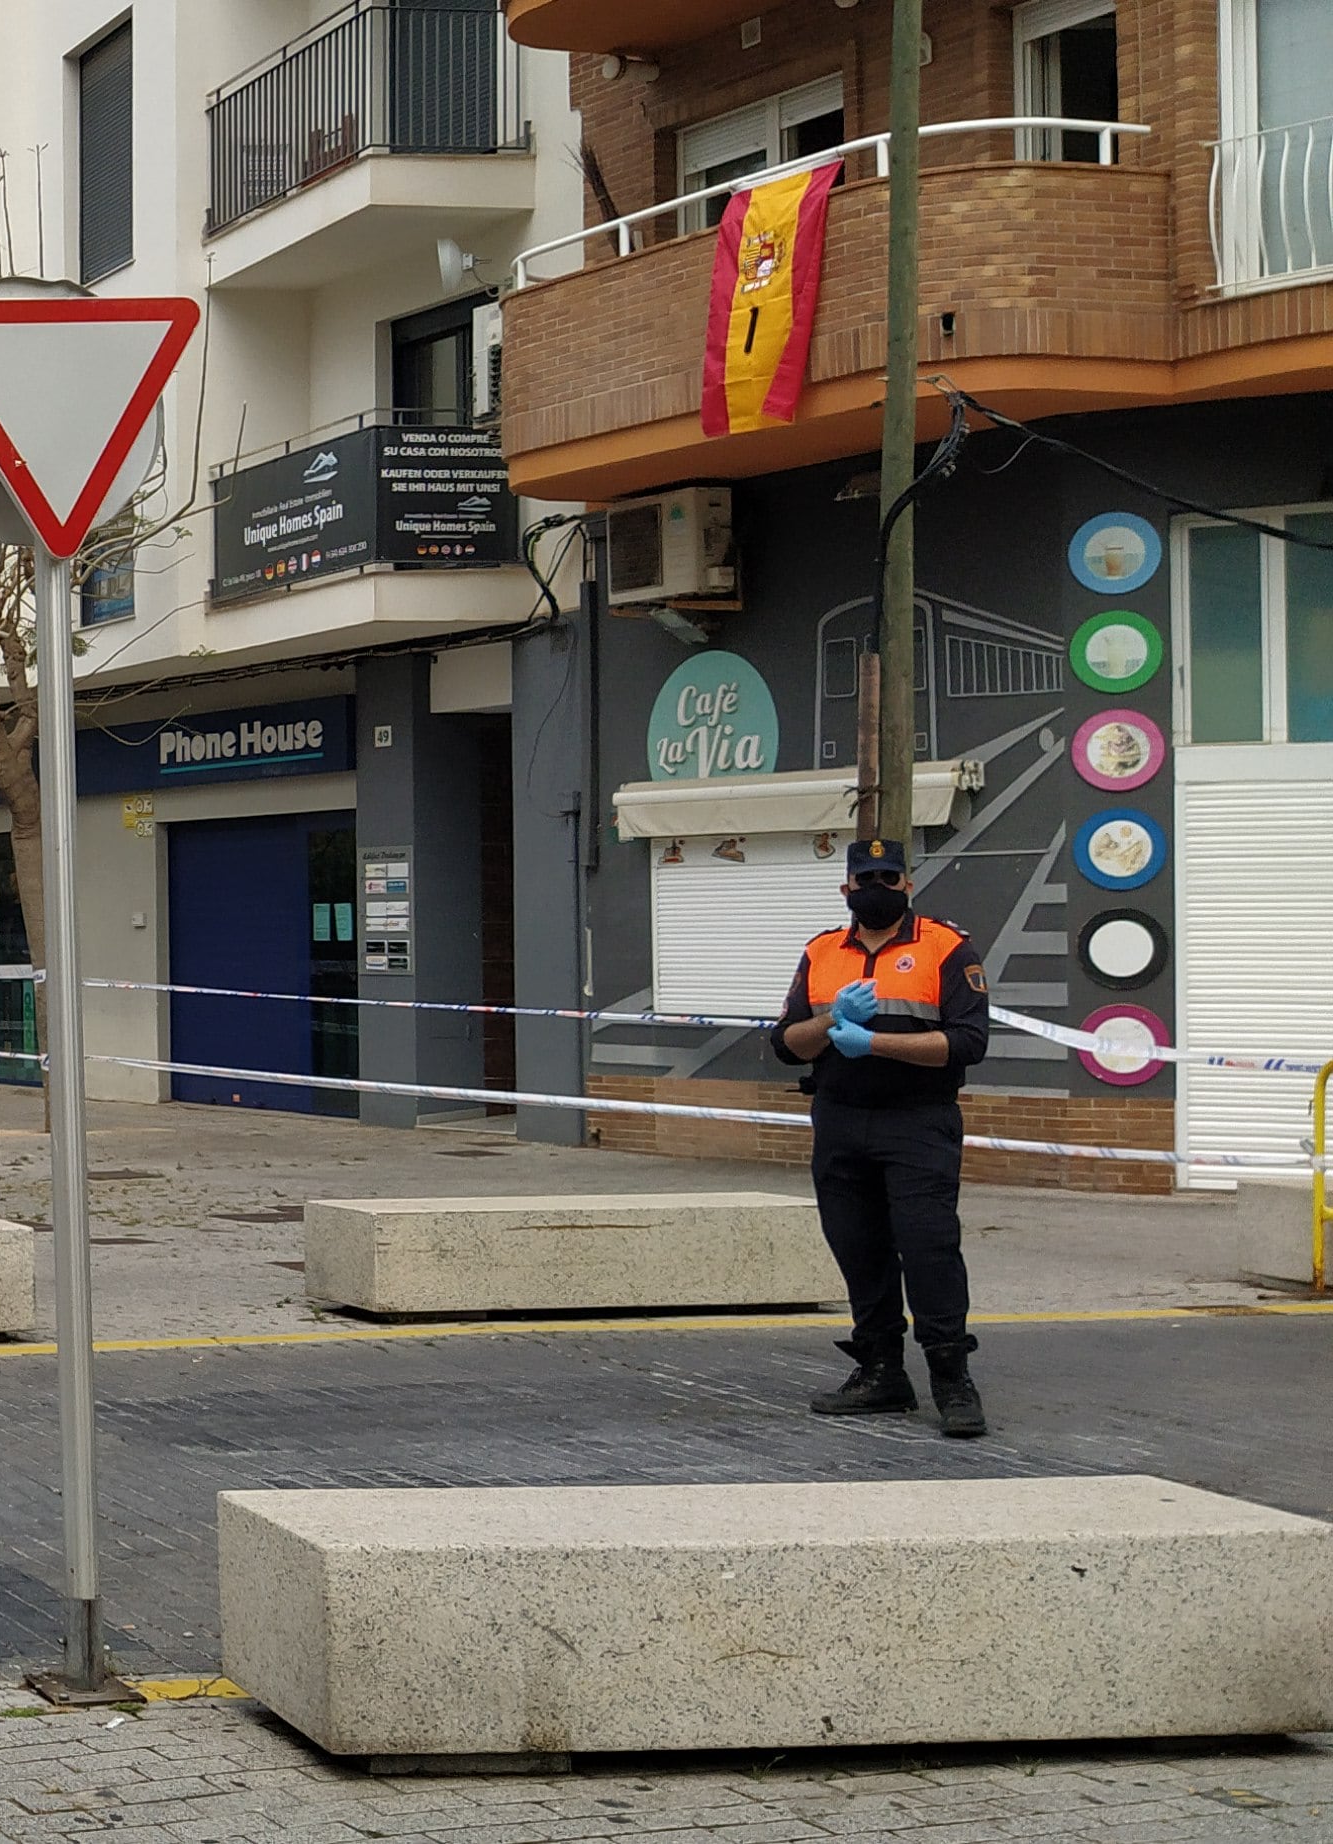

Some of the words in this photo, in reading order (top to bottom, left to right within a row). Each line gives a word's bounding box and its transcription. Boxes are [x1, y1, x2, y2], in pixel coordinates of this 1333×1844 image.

[401, 433, 437, 443] VENDA
[438, 433, 446, 443] O
[447, 433, 490, 444] COMPRE
[383, 447, 398, 457] SU
[399, 447, 427, 457] CASA
[427, 447, 449, 457] CON
[380, 469, 422, 479] KAUFEN
[423, 469, 450, 479] ODER
[392, 482, 407, 492] SIE
[408, 482, 426, 492] IHR
[427, 482, 454, 492] HAUS
[456, 483, 475, 493] MIT
[243, 520, 278, 547] Unique
[279, 511, 313, 536] Homes
[313, 500, 343, 530] Spain
[395, 520, 431, 534] Unique
[432, 520, 467, 532] Homes
[467, 520, 496, 534] Spain
[676, 682, 740, 726] Café
[160, 730, 237, 765] Phone
[239, 719, 323, 756] House
[377, 729, 389, 743] 49
[656, 737, 687, 775] La
[685, 724, 765, 779] Via
